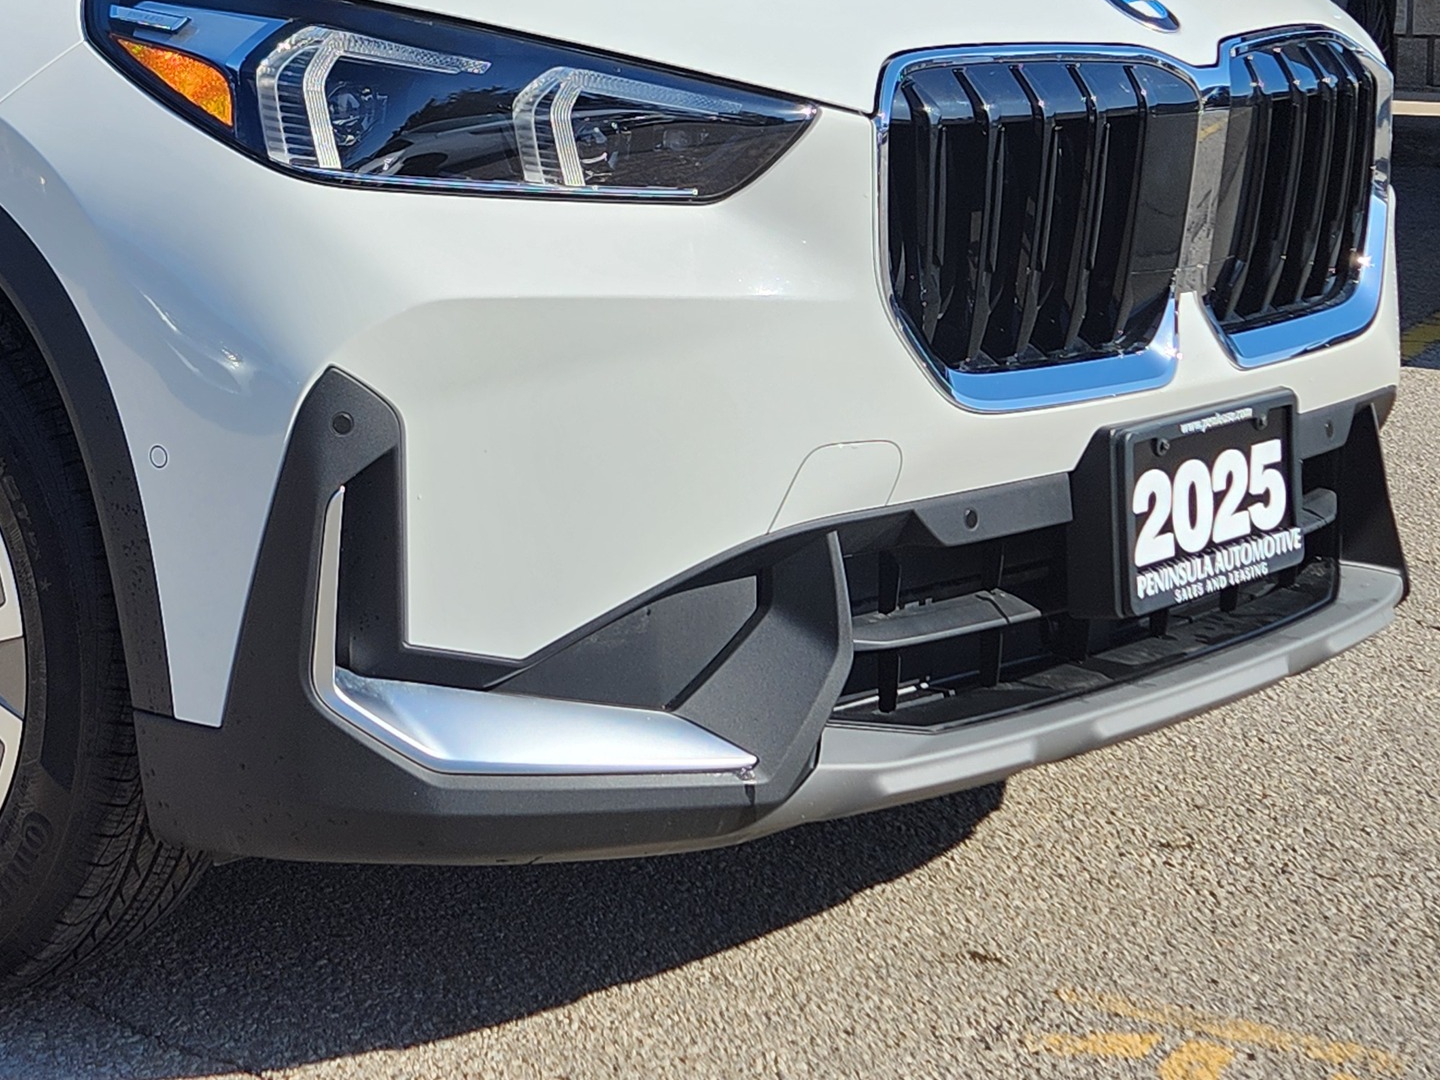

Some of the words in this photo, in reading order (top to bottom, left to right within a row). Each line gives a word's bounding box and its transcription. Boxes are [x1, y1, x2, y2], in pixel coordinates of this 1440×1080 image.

[1132, 438, 1287, 568] 2025
[1136, 554, 1214, 600] PENINSULA
[1215, 527, 1302, 577] AUTOMOTIVE
[1174, 582, 1204, 603] SALES
[1206, 574, 1228, 593] AND
[1228, 562, 1269, 586] LEASING
